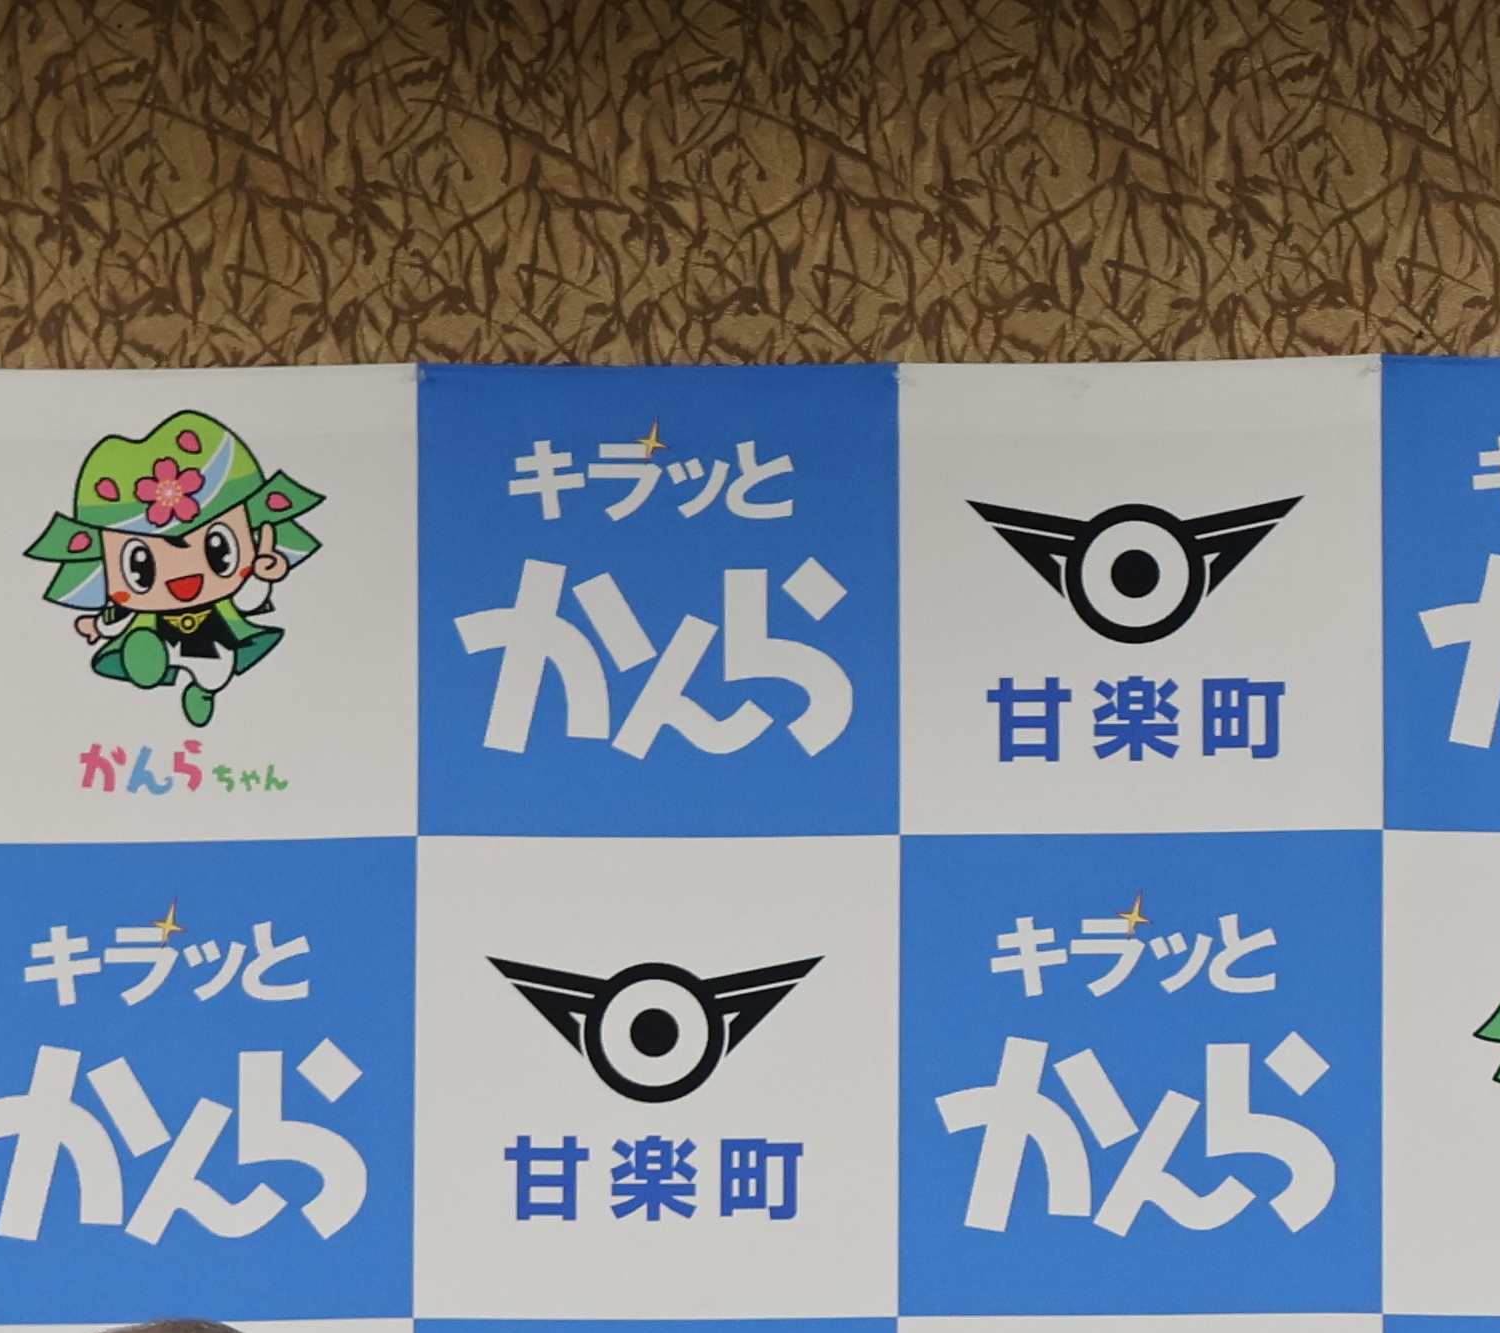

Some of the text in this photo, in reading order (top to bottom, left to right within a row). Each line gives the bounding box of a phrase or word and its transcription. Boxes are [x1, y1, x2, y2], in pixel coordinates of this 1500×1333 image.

[510, 441, 793, 520] キラッと
[455, 558, 852, 758] かんら
[988, 677, 1284, 761] 甘楽町
[81, 740, 286, 794] かんらちゃん
[25, 921, 309, 1005] キラッと
[992, 914, 1276, 996] キラッと
[936, 1032, 1335, 1236] かんら
[505, 1136, 802, 1220] 甘楽町
